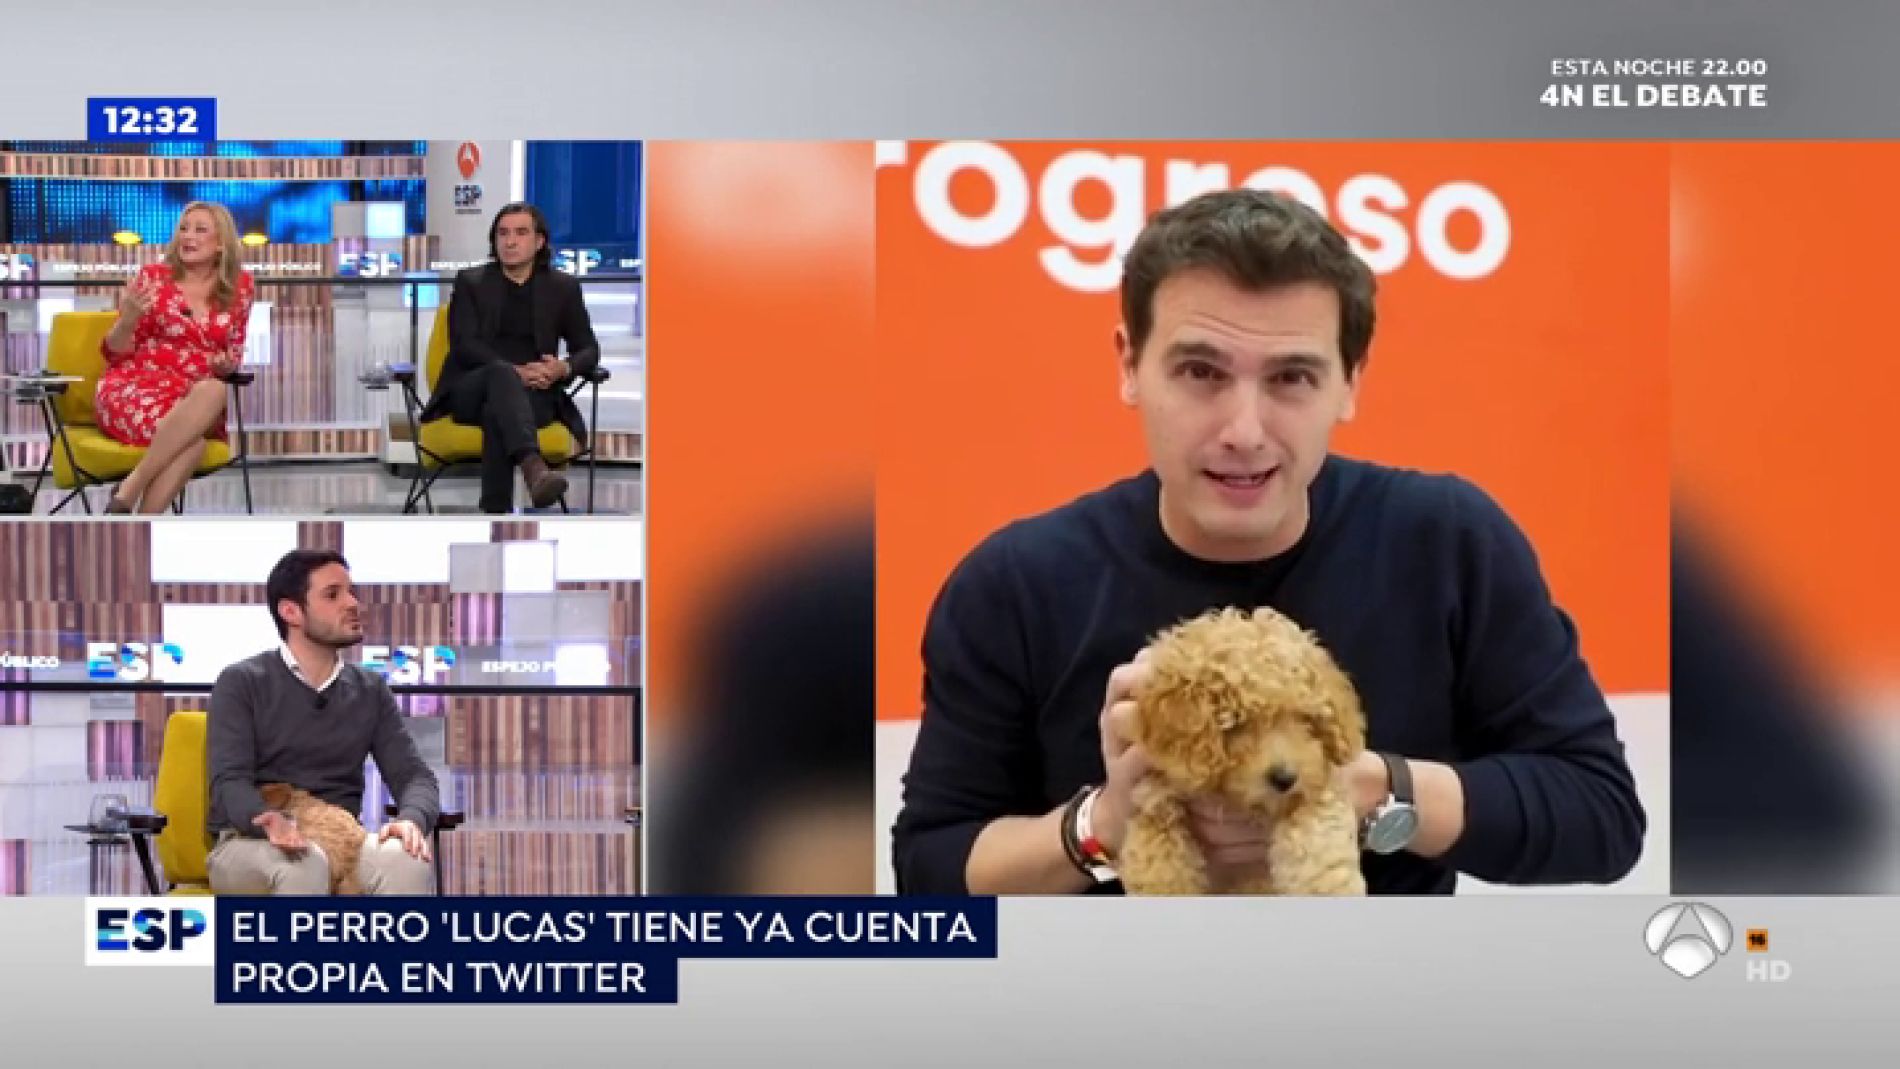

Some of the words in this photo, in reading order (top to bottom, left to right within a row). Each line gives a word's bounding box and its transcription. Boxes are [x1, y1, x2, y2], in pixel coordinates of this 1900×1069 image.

[338, 253, 402, 277] ESP
[86, 643, 184, 682] ESP
[361, 645, 456, 683] ESP
